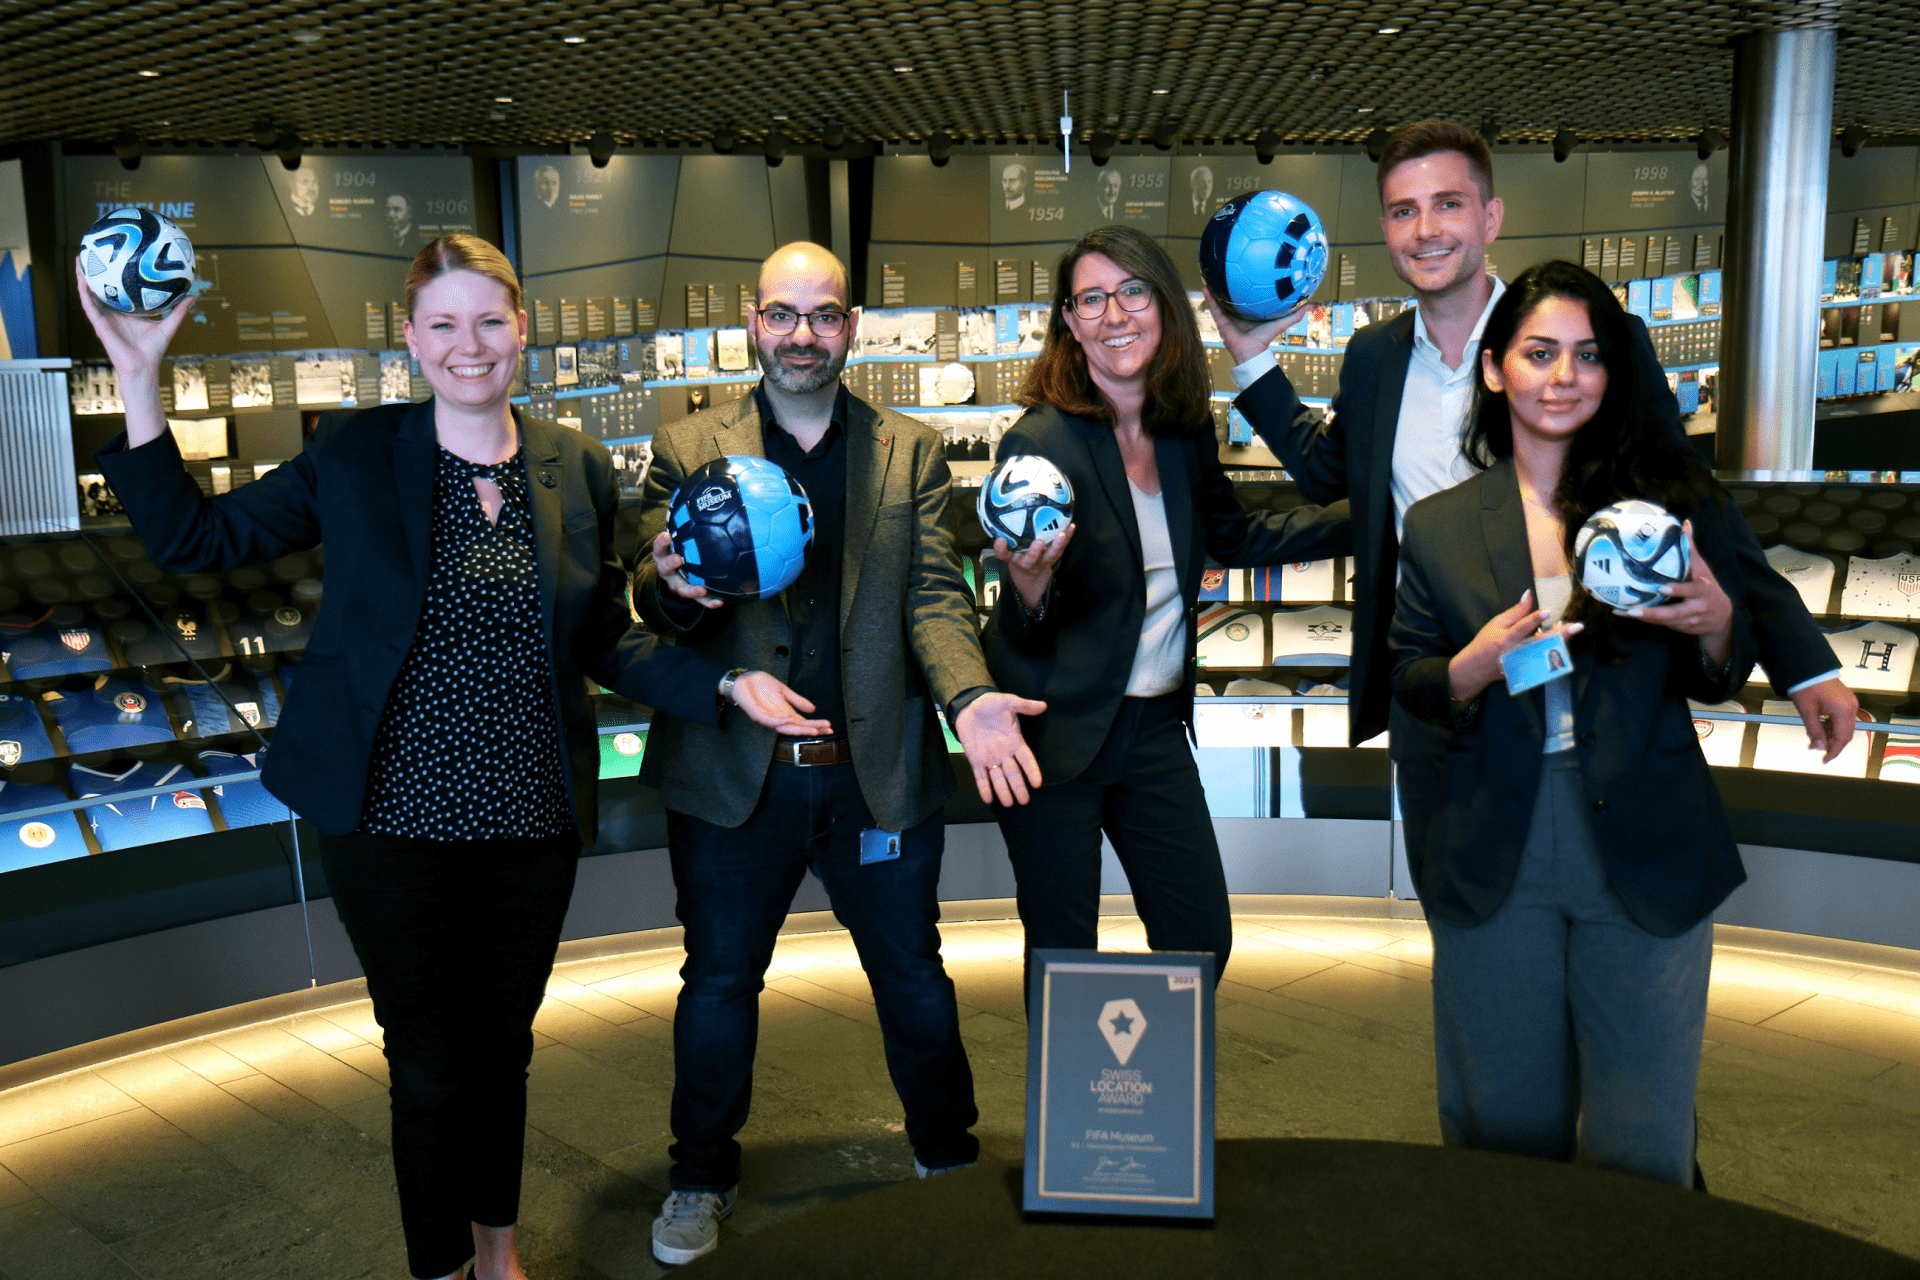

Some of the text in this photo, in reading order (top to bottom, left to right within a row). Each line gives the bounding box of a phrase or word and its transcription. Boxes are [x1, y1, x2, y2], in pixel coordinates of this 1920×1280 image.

[333, 171, 376, 187] 1904
[1129, 173, 1165, 188] 1955
[1633, 166, 1668, 180] 1998
[1225, 176, 1260, 190] 1961
[425, 199, 468, 215] 1906
[1028, 206, 1065, 221] 1954
[696, 492, 712, 504] FIFA
[698, 490, 732, 511] MUSEUM
[239, 636, 265, 655] 11
[1855, 640, 1898, 672] H
[1101, 1068, 1142, 1080] SWISS
[1090, 1080, 1153, 1093] LOCATION
[1098, 1091, 1145, 1106] AWARD
[1085, 1128, 1154, 1143] FIFA Museum
